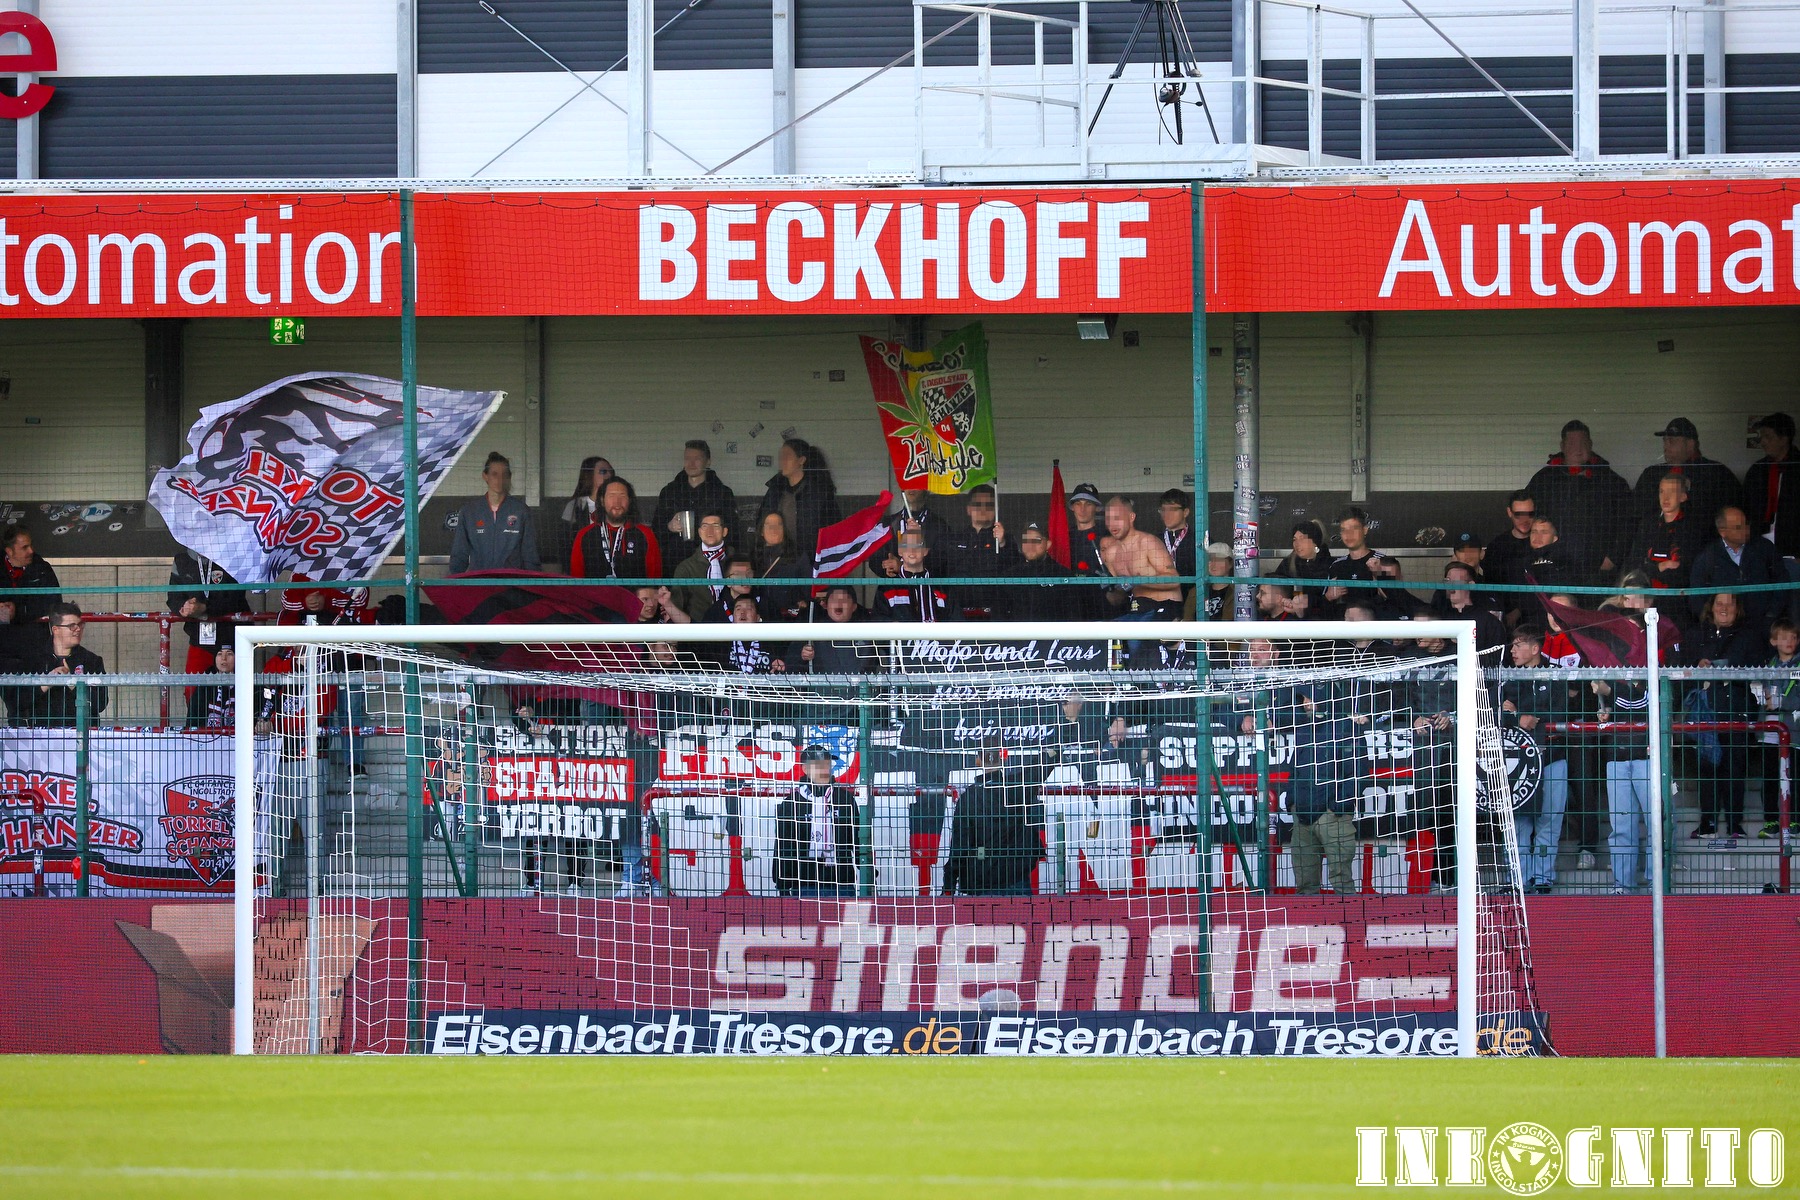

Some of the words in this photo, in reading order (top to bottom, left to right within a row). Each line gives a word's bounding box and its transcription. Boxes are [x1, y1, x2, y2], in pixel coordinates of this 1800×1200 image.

[638, 200, 1149, 302] BECKHOFF
[984, 640, 1040, 661] und
[495, 760, 628, 801] STADION
[159, 815, 230, 836] TORKEL
[497, 804, 627, 840] VERBOT
[200, 857, 222, 868] 2014
[432, 1014, 695, 1055] Eisenbach
[984, 1016, 1252, 1056] Eisenbach
